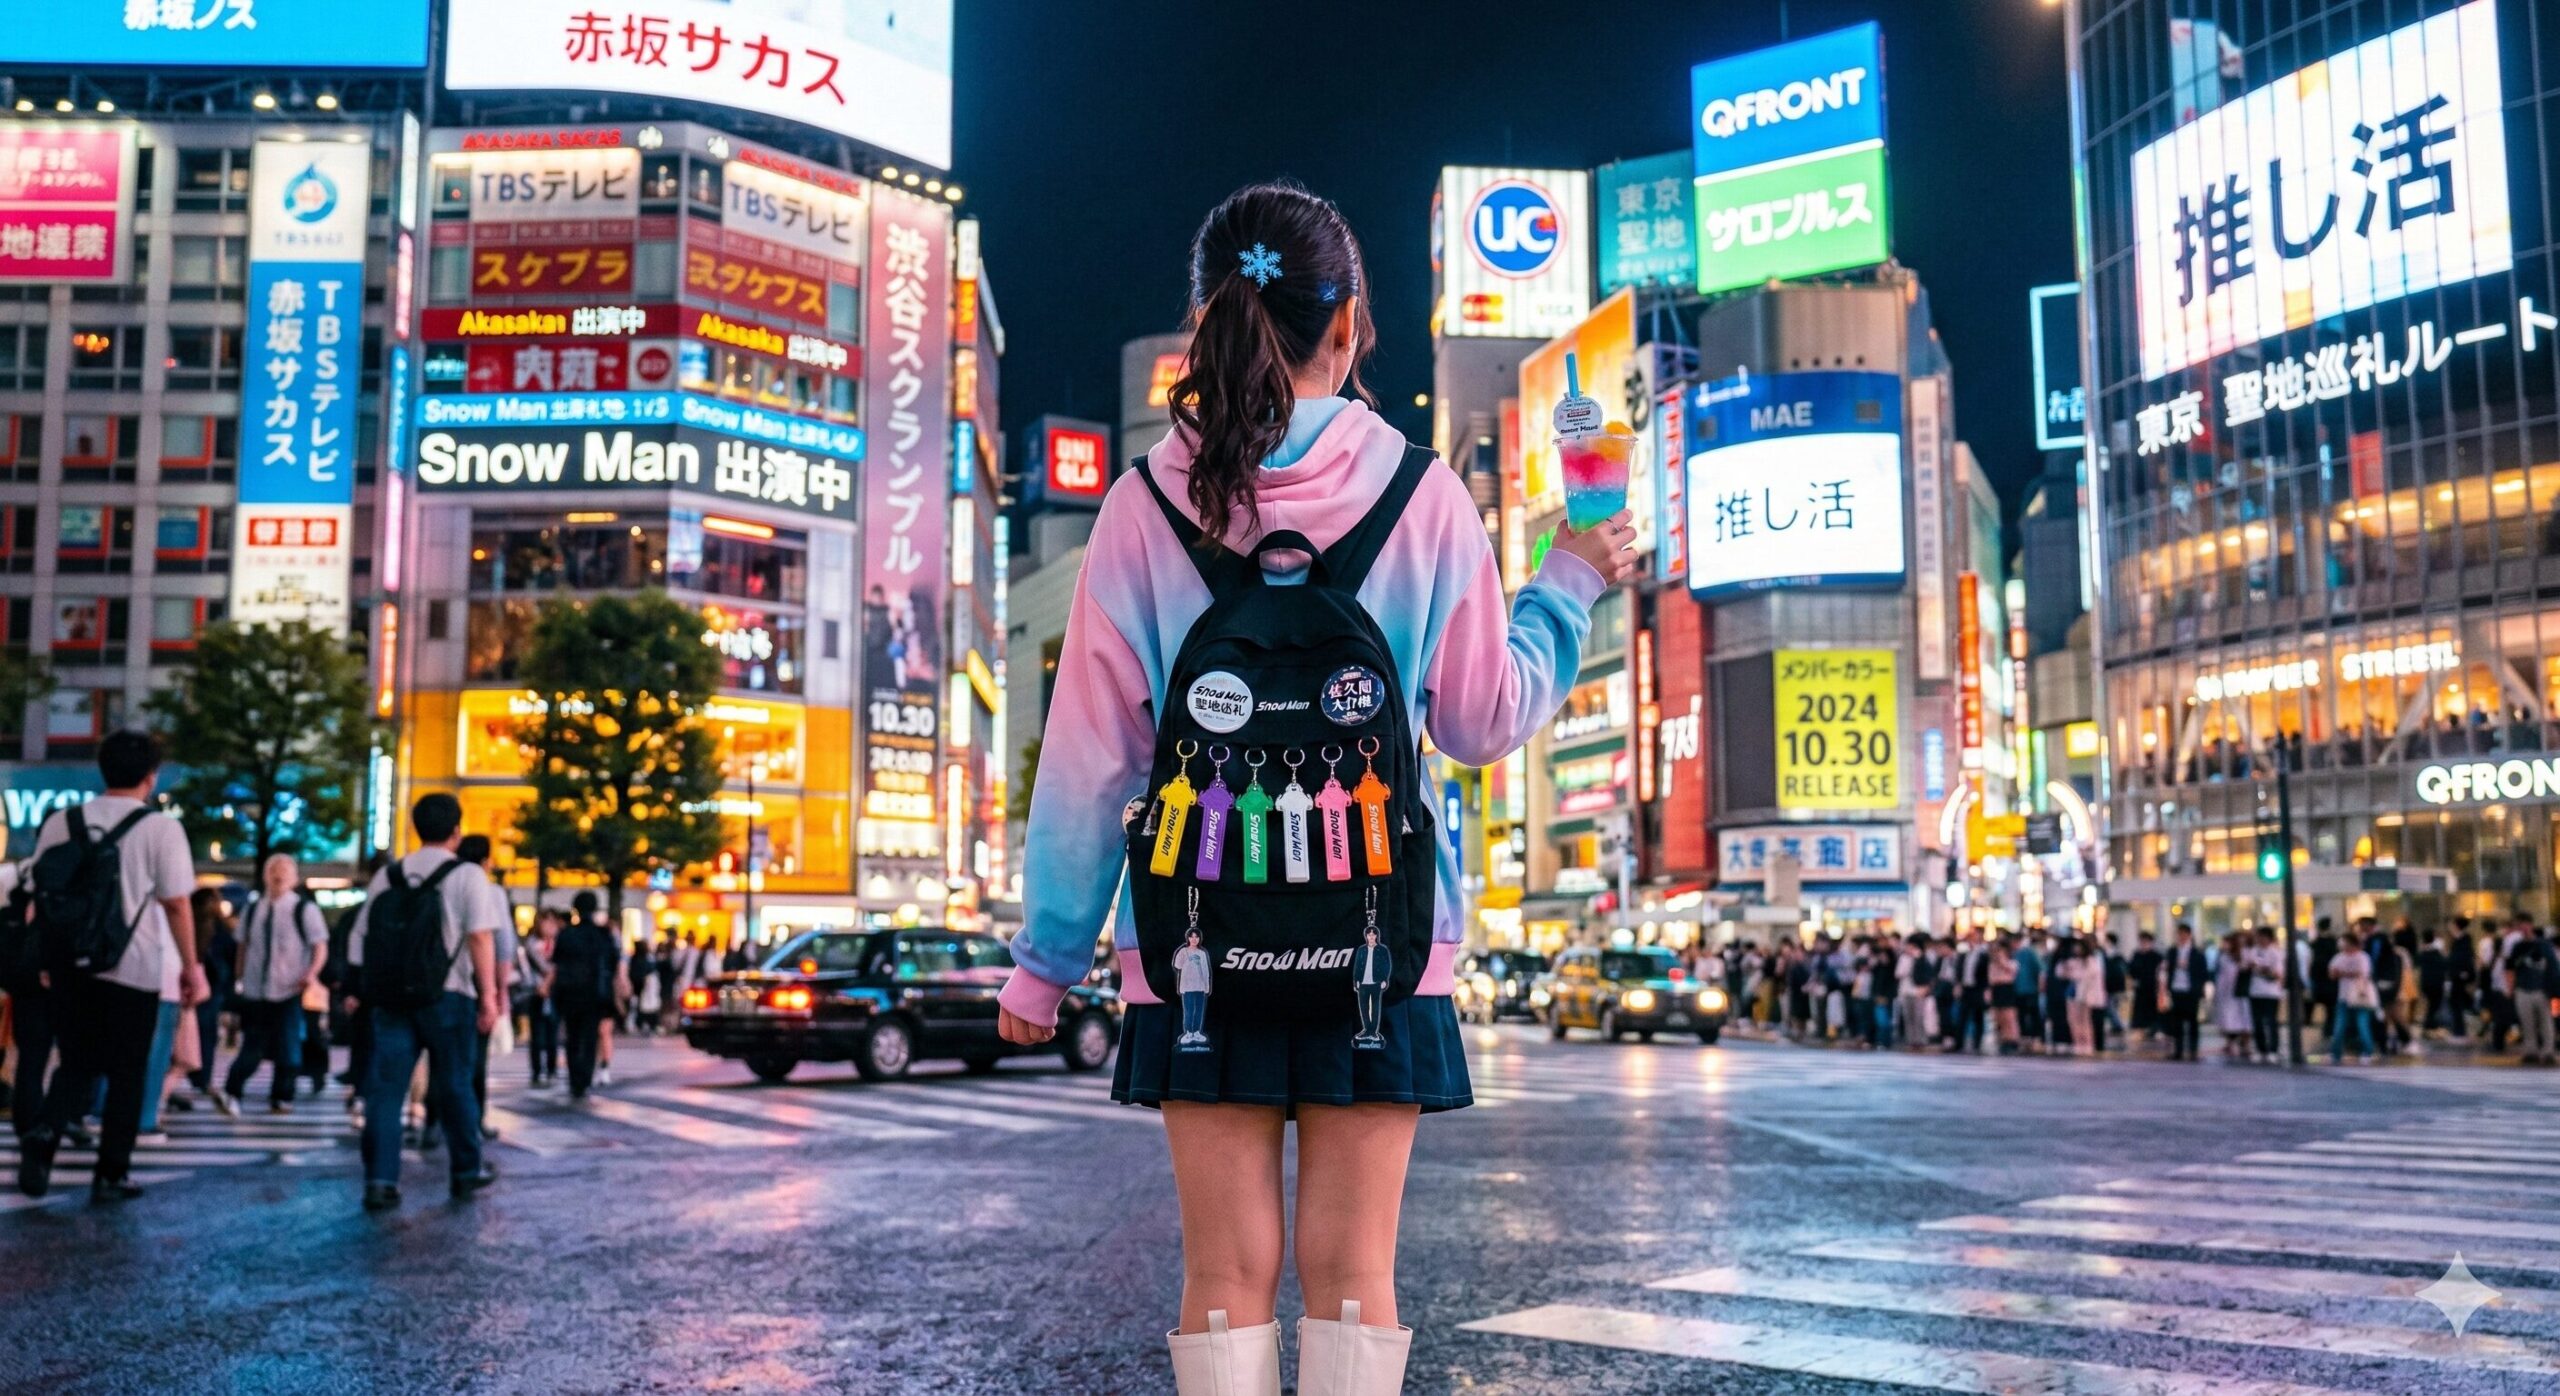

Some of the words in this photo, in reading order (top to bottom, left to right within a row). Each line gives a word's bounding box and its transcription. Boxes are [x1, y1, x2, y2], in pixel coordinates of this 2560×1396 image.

[565, 11, 847, 105] 赤坂サカス
[1701, 66, 1866, 138] QFRONT
[479, 168, 629, 201] TBSテレビ
[2173, 93, 2457, 308] 推し活
[729, 182, 851, 244] TBSテレビ
[1478, 205, 1557, 254] UC
[262, 278, 306, 467] 赤坂サカス
[307, 280, 344, 483] TBSテレビ
[2135, 390, 2205, 457] 東京
[2223, 296, 2560, 428] 聖地巡礼ルート
[424, 398, 492, 423] Snow
[496, 397, 547, 421] Man
[682, 397, 740, 430] Snow
[883, 222, 930, 576] 渋谷スクランブル
[1750, 401, 1814, 431] MAE
[418, 432, 570, 485] Snow
[583, 431, 700, 484] Man
[715, 440, 851, 511] 出演中
[1715, 479, 1855, 543] 推し活
[1782, 658, 1890, 680] メンバーカラー
[868, 700, 936, 738] 10.30
[1255, 701, 1287, 711] Snow
[1286, 700, 1311, 710] Man
[1797, 693, 1879, 723] 2024
[1783, 730, 1891, 767] 10.30
[1784, 774, 1893, 797] RELEASE
[1220, 947, 1297, 971] Snow
[1296, 946, 1355, 970] Man
